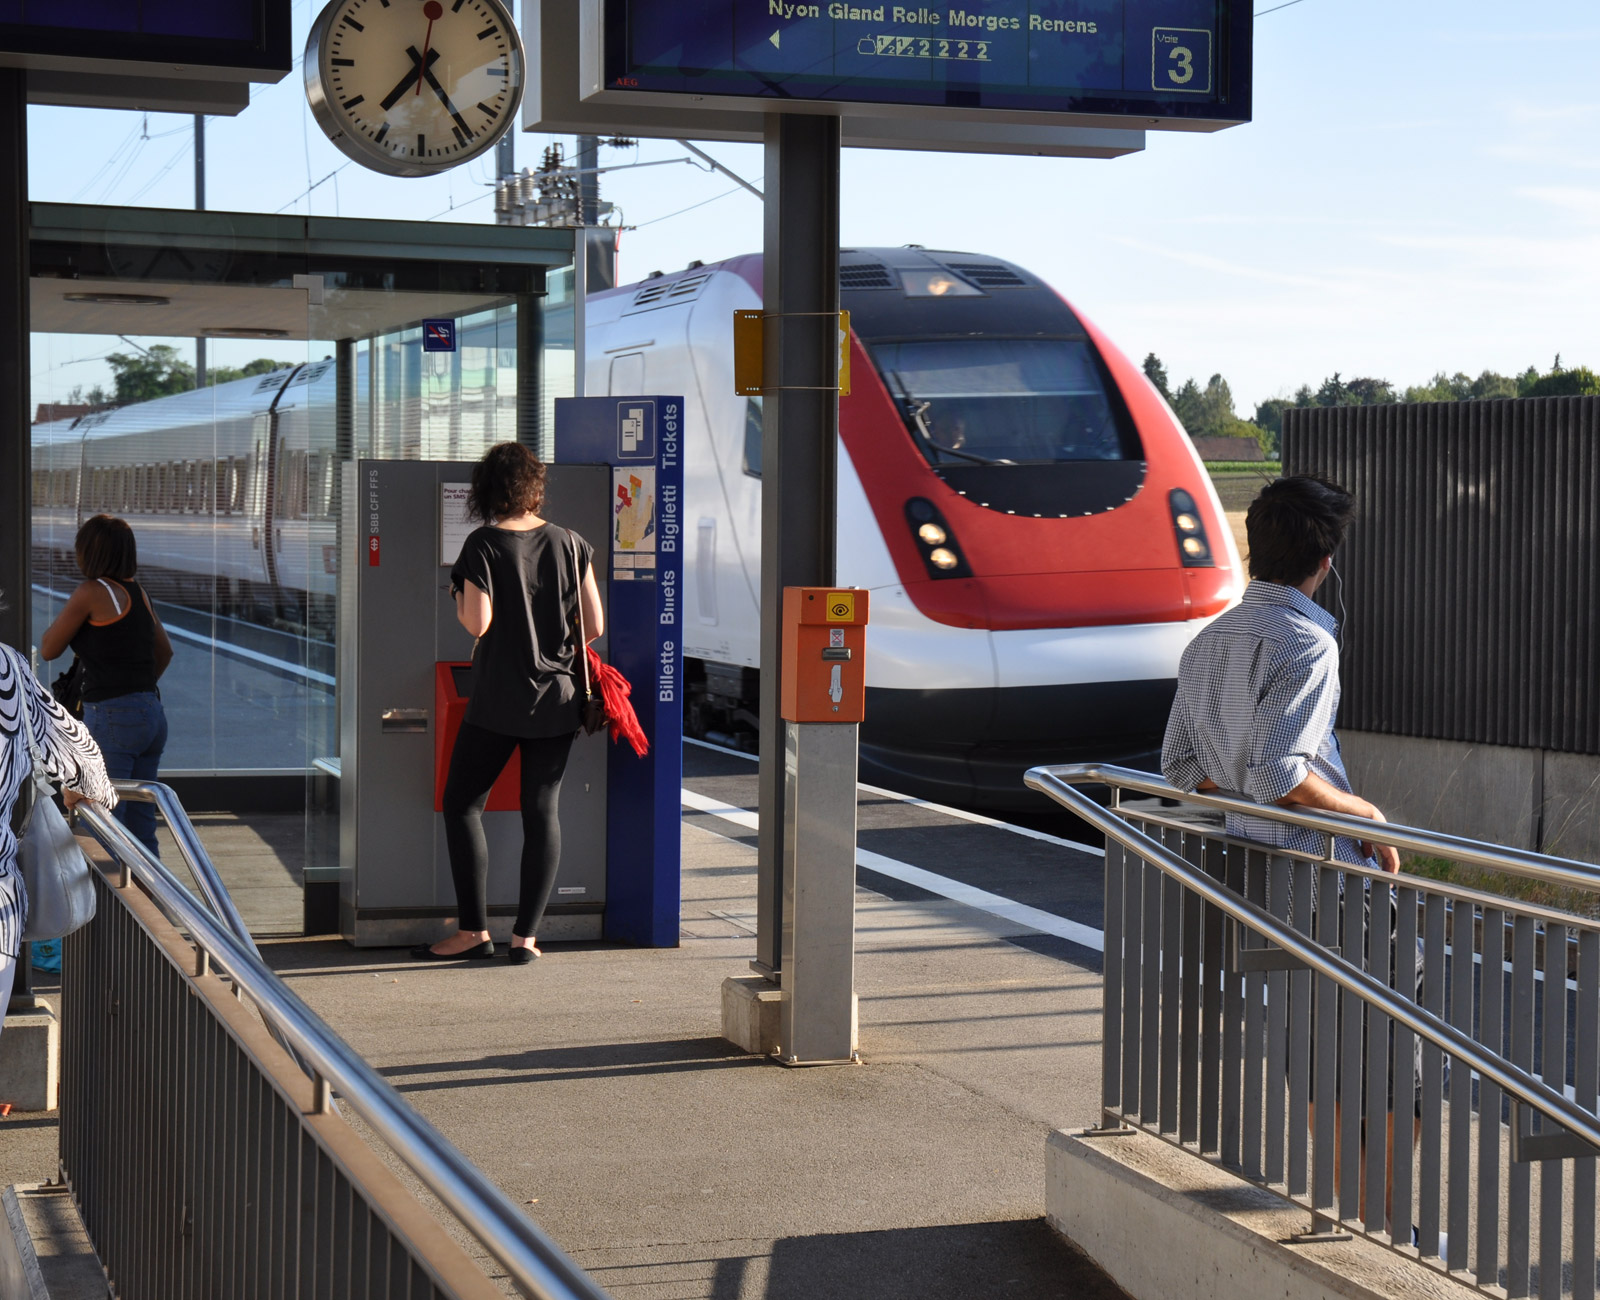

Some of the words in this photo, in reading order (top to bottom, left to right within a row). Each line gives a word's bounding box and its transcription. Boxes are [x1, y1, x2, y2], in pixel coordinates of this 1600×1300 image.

[768, 0, 820, 19] Nyon
[828, 3, 884, 22] Gland
[892, 6, 940, 25] Rolle
[949, 10, 1020, 31] Morges
[1029, 14, 1098, 34] Renens
[1157, 33, 1179, 43] Voie
[919, 39, 930, 56] 2
[939, 40, 950, 57] 2
[958, 42, 969, 58] 2
[977, 43, 988, 59] 2
[1168, 46, 1194, 84] 3
[615, 77, 639, 87] AEG
[661, 403, 678, 470] Tickets
[369, 469, 379, 489] FFS
[369, 491, 379, 511] CFF
[369, 513, 380, 534] SBB
[661, 485, 680, 552] Biglietti
[659, 640, 675, 702] Billette
